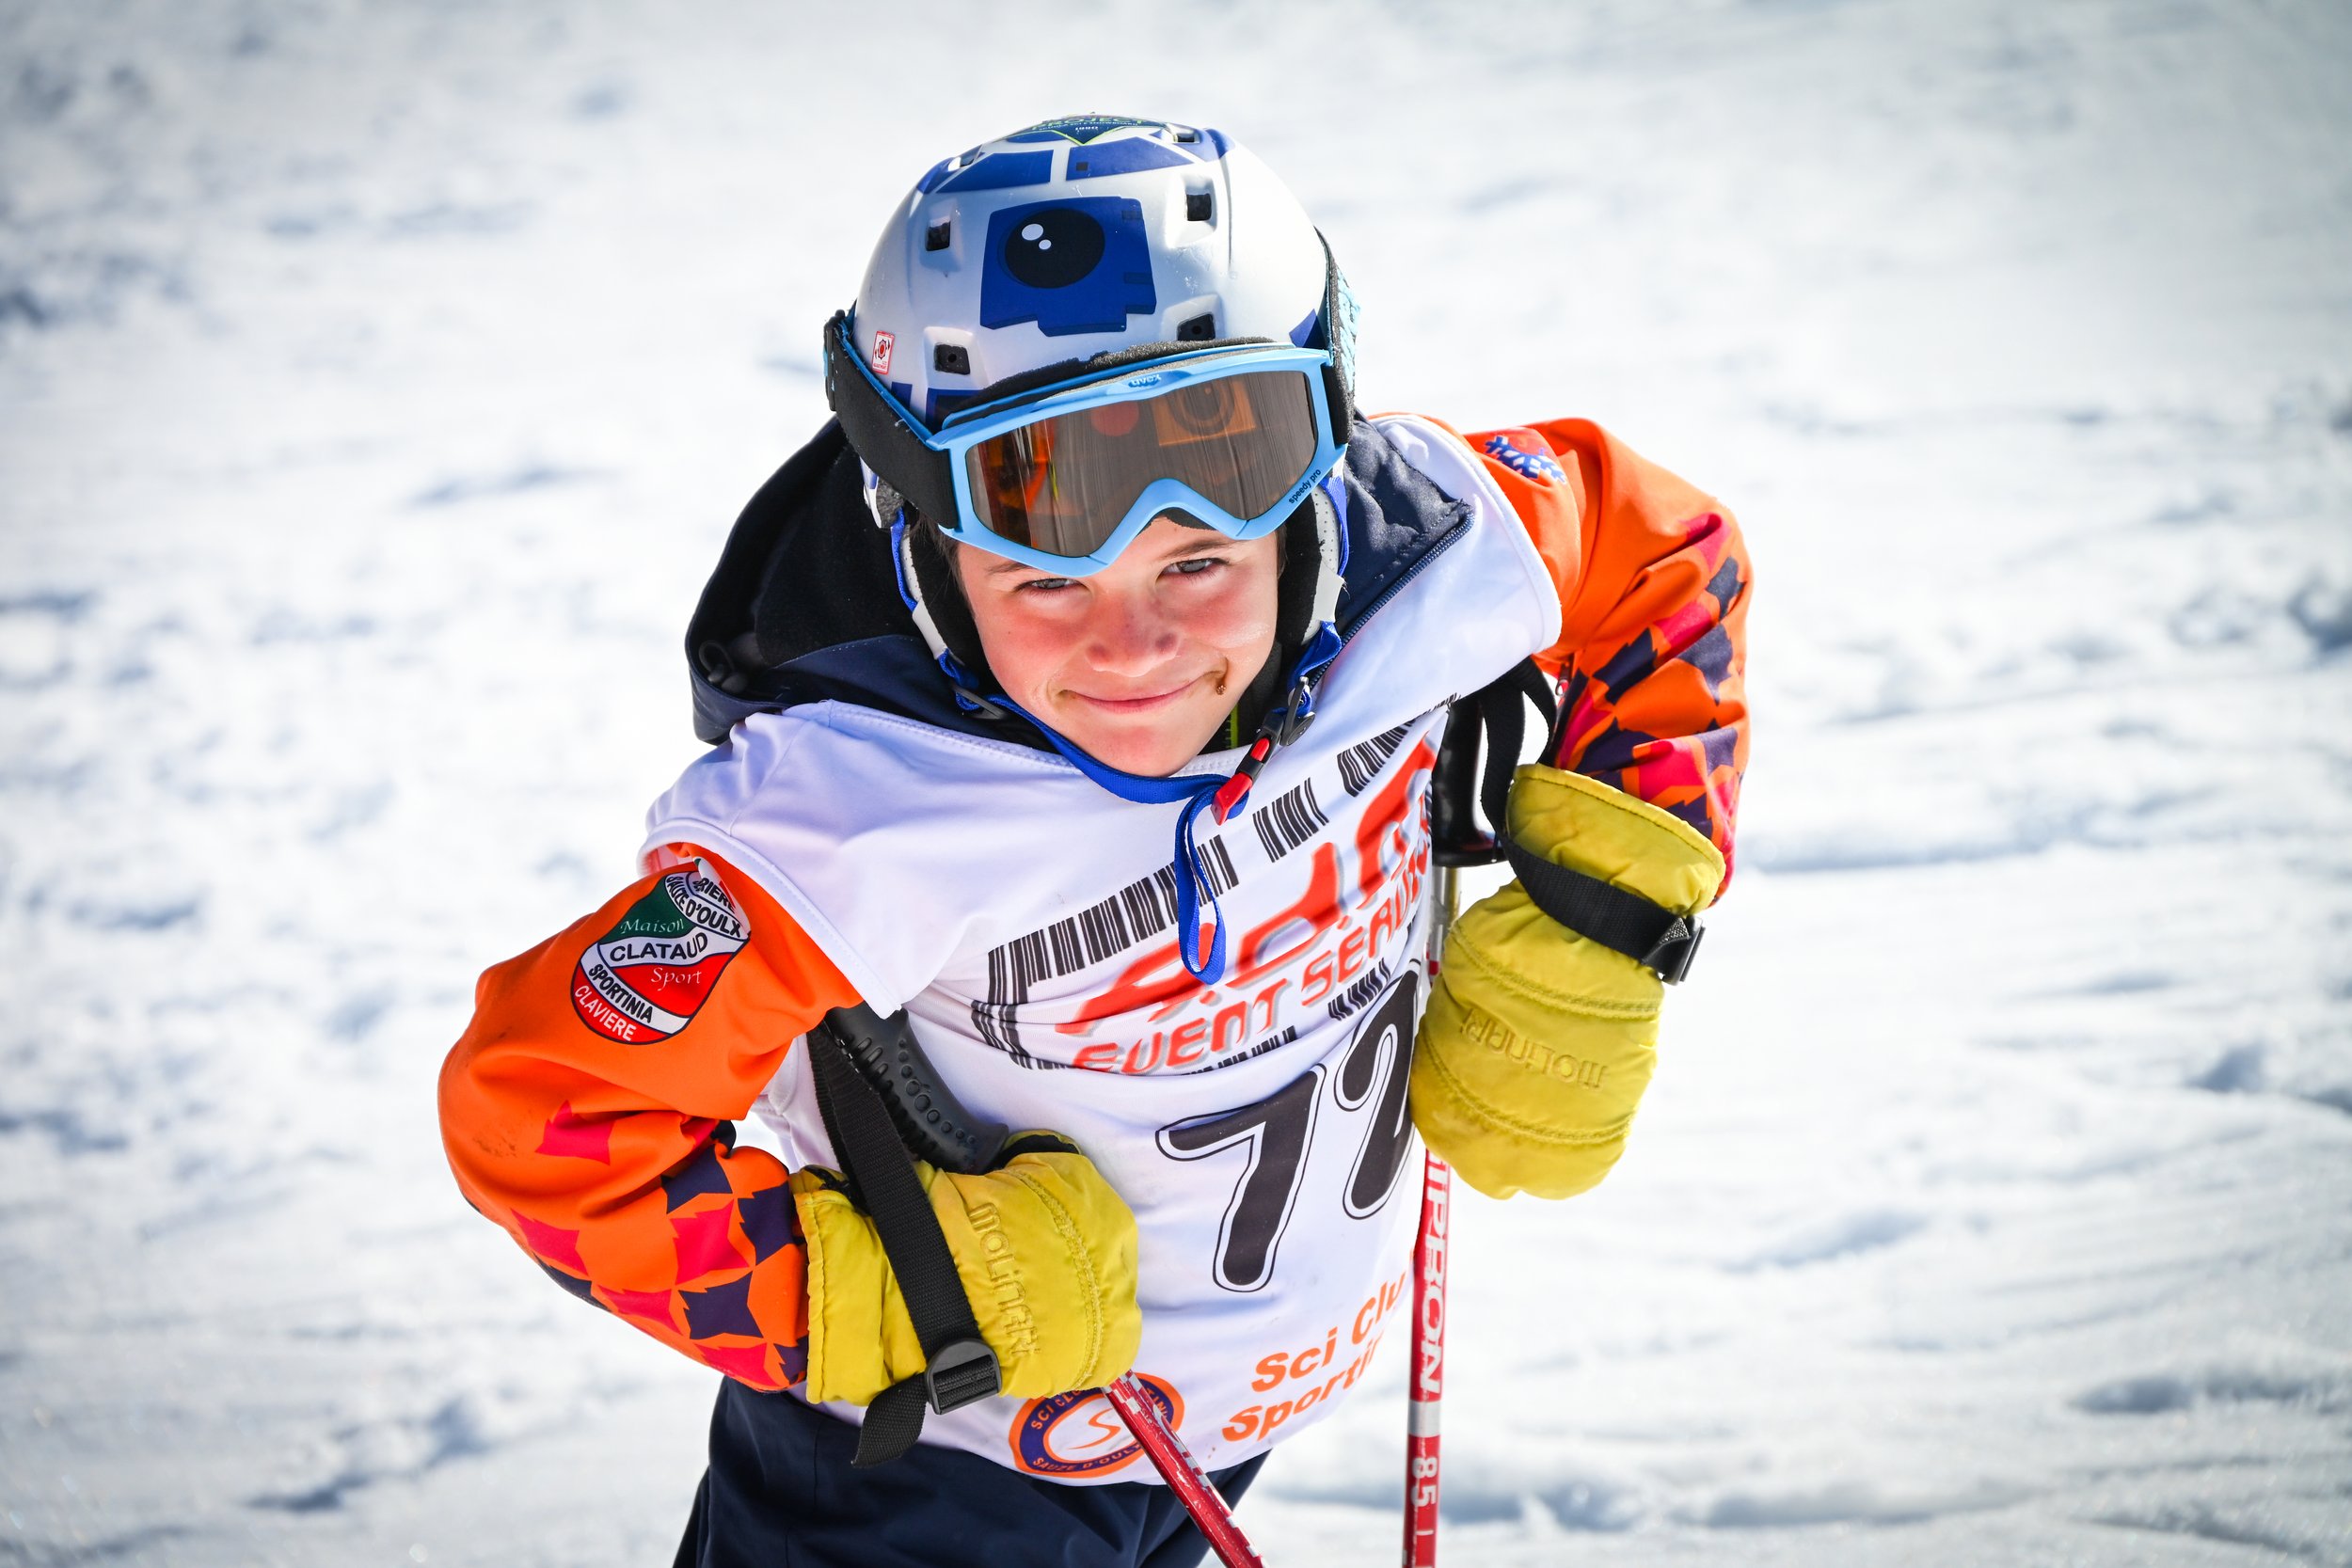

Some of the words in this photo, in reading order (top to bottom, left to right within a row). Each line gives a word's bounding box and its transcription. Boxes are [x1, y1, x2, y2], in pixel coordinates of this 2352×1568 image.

[1289, 480, 1311, 504] speedy
[1310, 469, 1322, 483] pro
[620, 918, 685, 934] Maison
[685, 898, 741, 938] D'OULX
[610, 932, 707, 961] CLATAUD
[588, 963, 653, 1023] SPORTINIA
[650, 966, 702, 991] Sport
[574, 985, 637, 1041] CLAVIERE
[1155, 958, 1419, 1293] 72
[1420, 1150, 1449, 1394] IPRON
[1251, 1326, 1338, 1393] Sci
[1351, 1270, 1407, 1345] Clu
[1031, 1404, 1055, 1431] SCI
[1055, 1389, 1083, 1407] CL
[1033, 1457, 1077, 1472] SAUZE
[1411, 1457, 1438, 1508] 85
